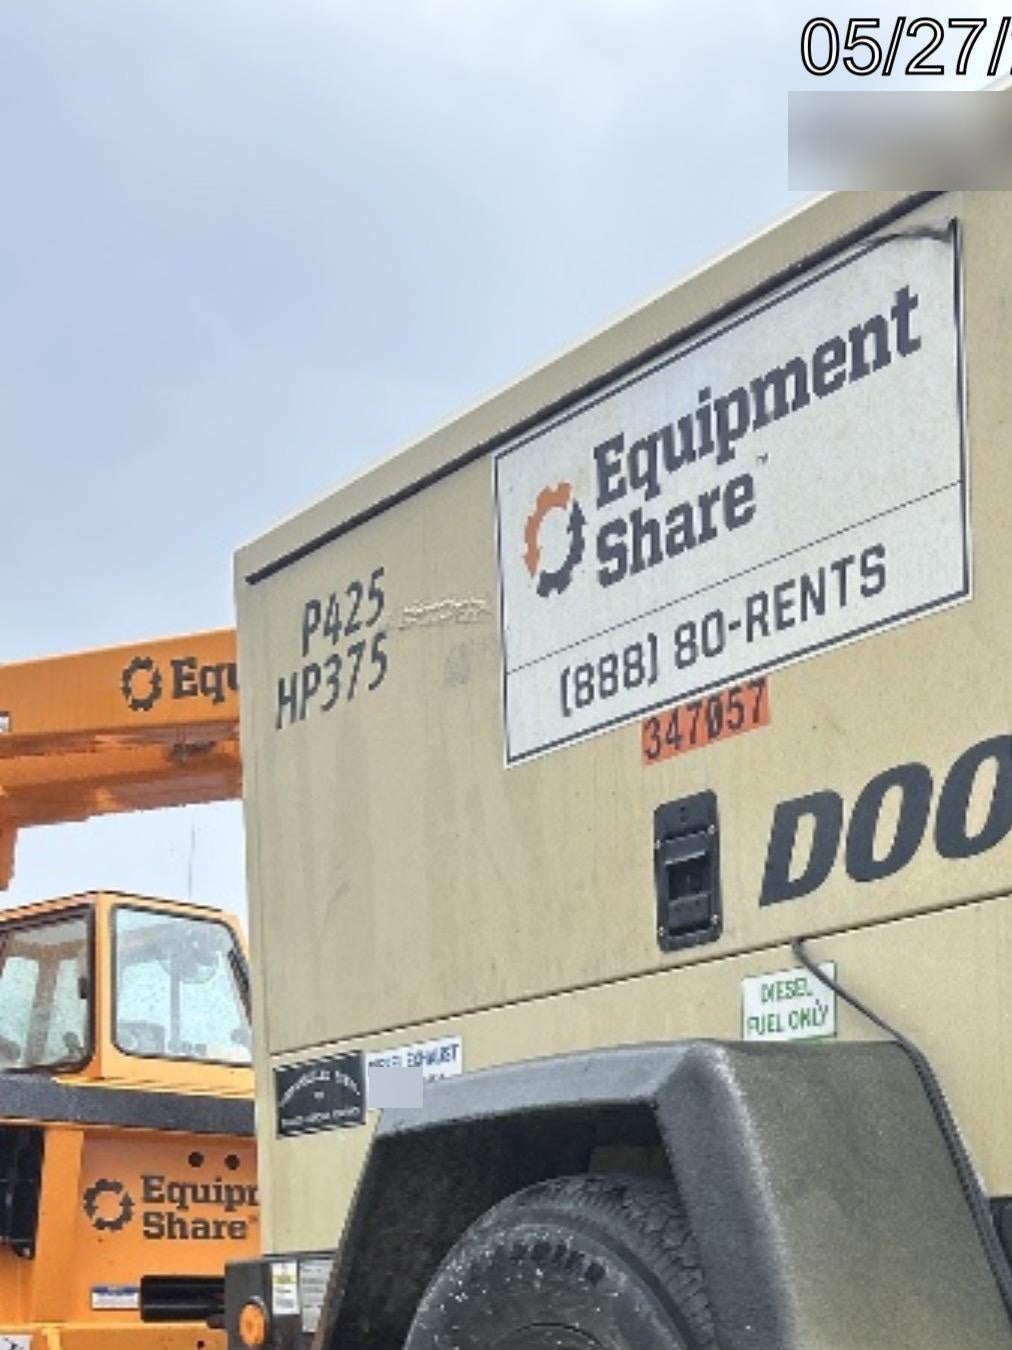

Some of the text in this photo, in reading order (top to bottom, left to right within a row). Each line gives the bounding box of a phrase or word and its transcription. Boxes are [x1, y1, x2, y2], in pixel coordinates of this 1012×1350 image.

[592, 285, 922, 508] Equipment
[595, 472, 757, 588] Share
[302, 566, 385, 658] P425
[561, 543, 887, 718] (888) 80-RENTS
[275, 631, 387, 731] HP375
[747, 1013, 785, 1035] FUEL
[761, 977, 814, 1003] DIESEL
[142, 1211, 247, 1240] Share
